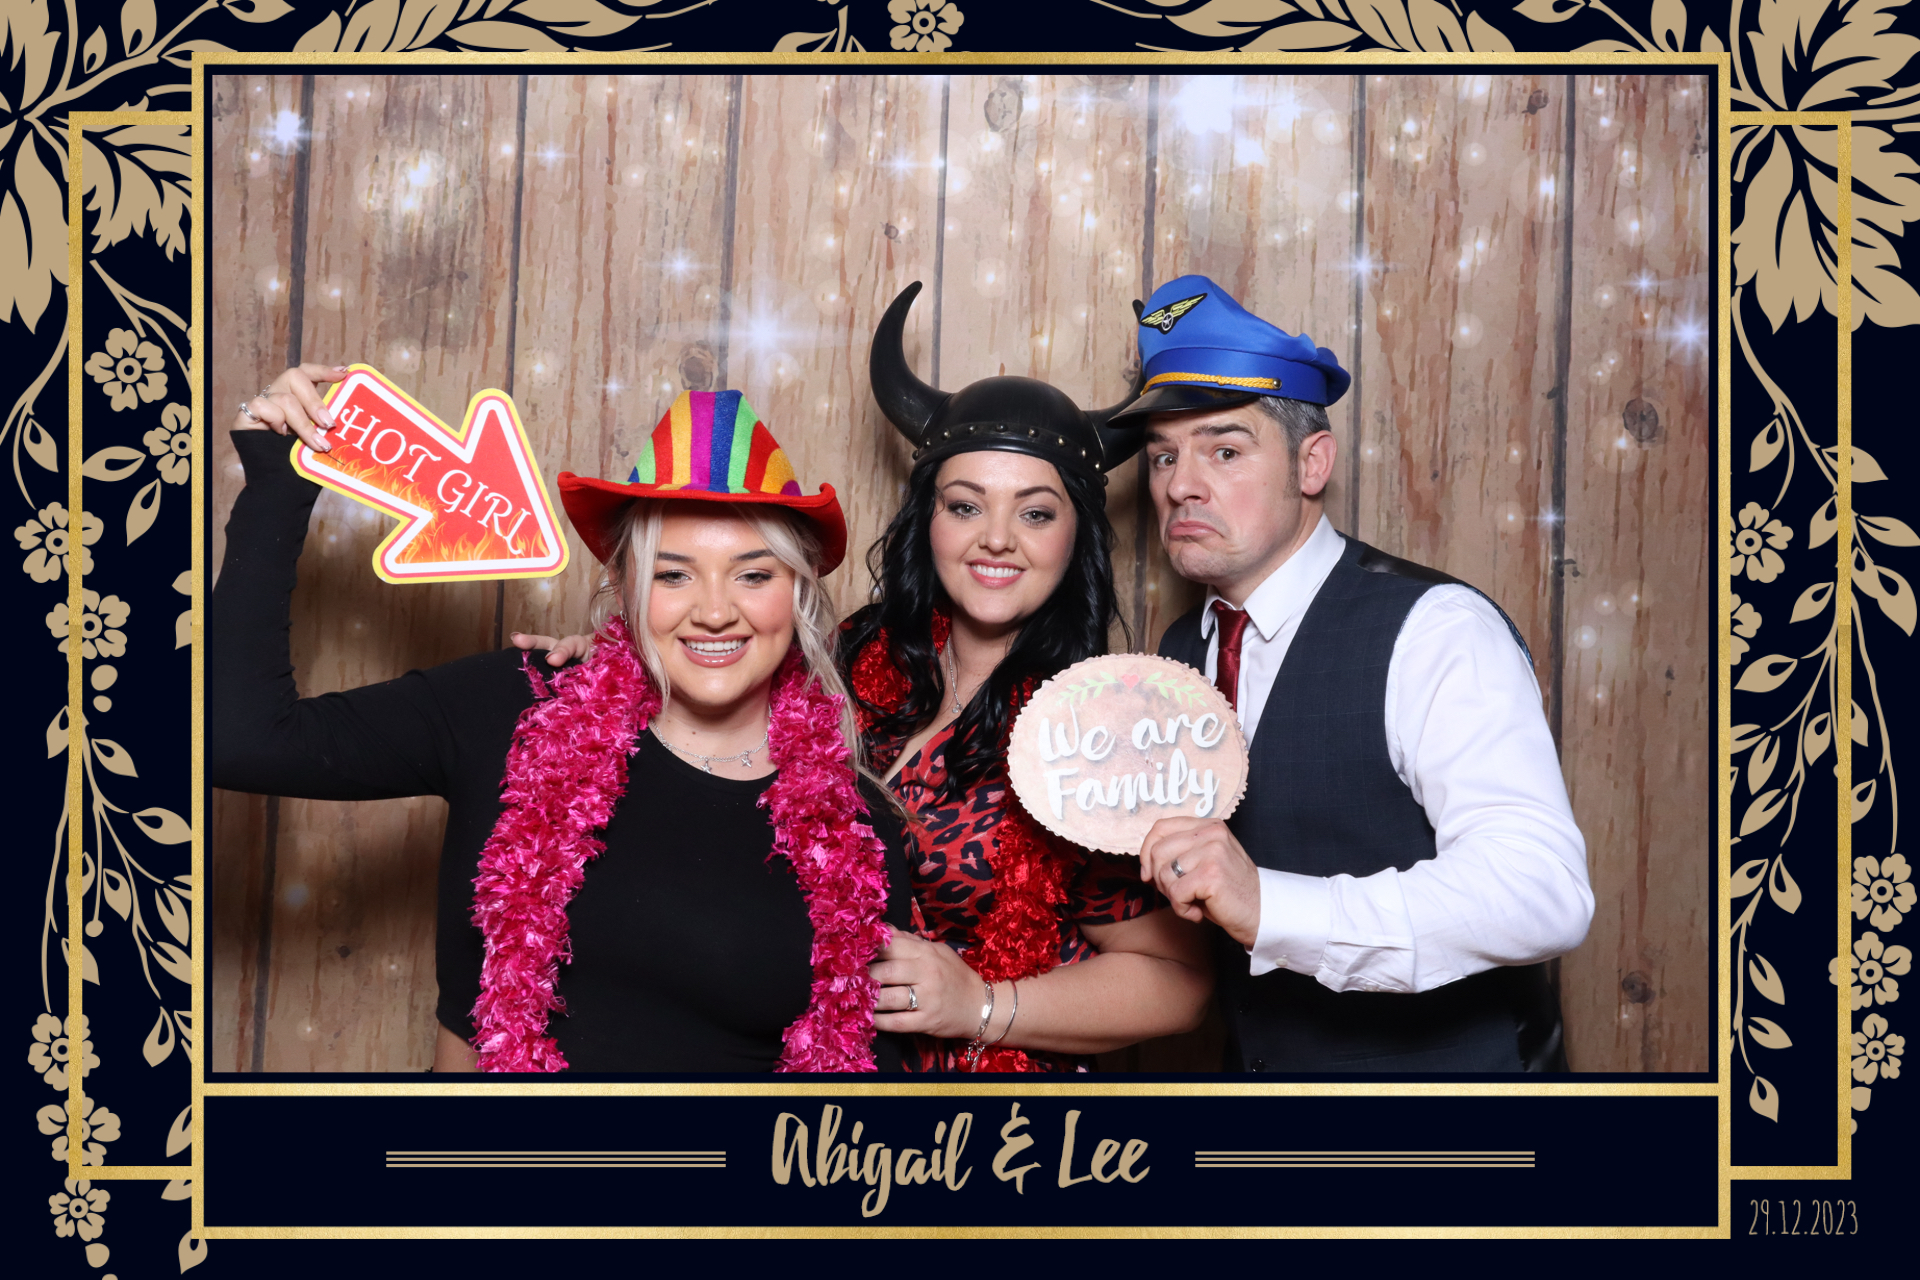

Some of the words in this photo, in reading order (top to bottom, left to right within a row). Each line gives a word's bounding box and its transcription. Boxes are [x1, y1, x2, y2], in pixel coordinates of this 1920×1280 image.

[335, 404, 442, 483] HOT
[436, 469, 532, 556] GIRL
[1038, 703, 1117, 763] We
[1131, 712, 1227, 750] are
[1045, 748, 1221, 820] Family
